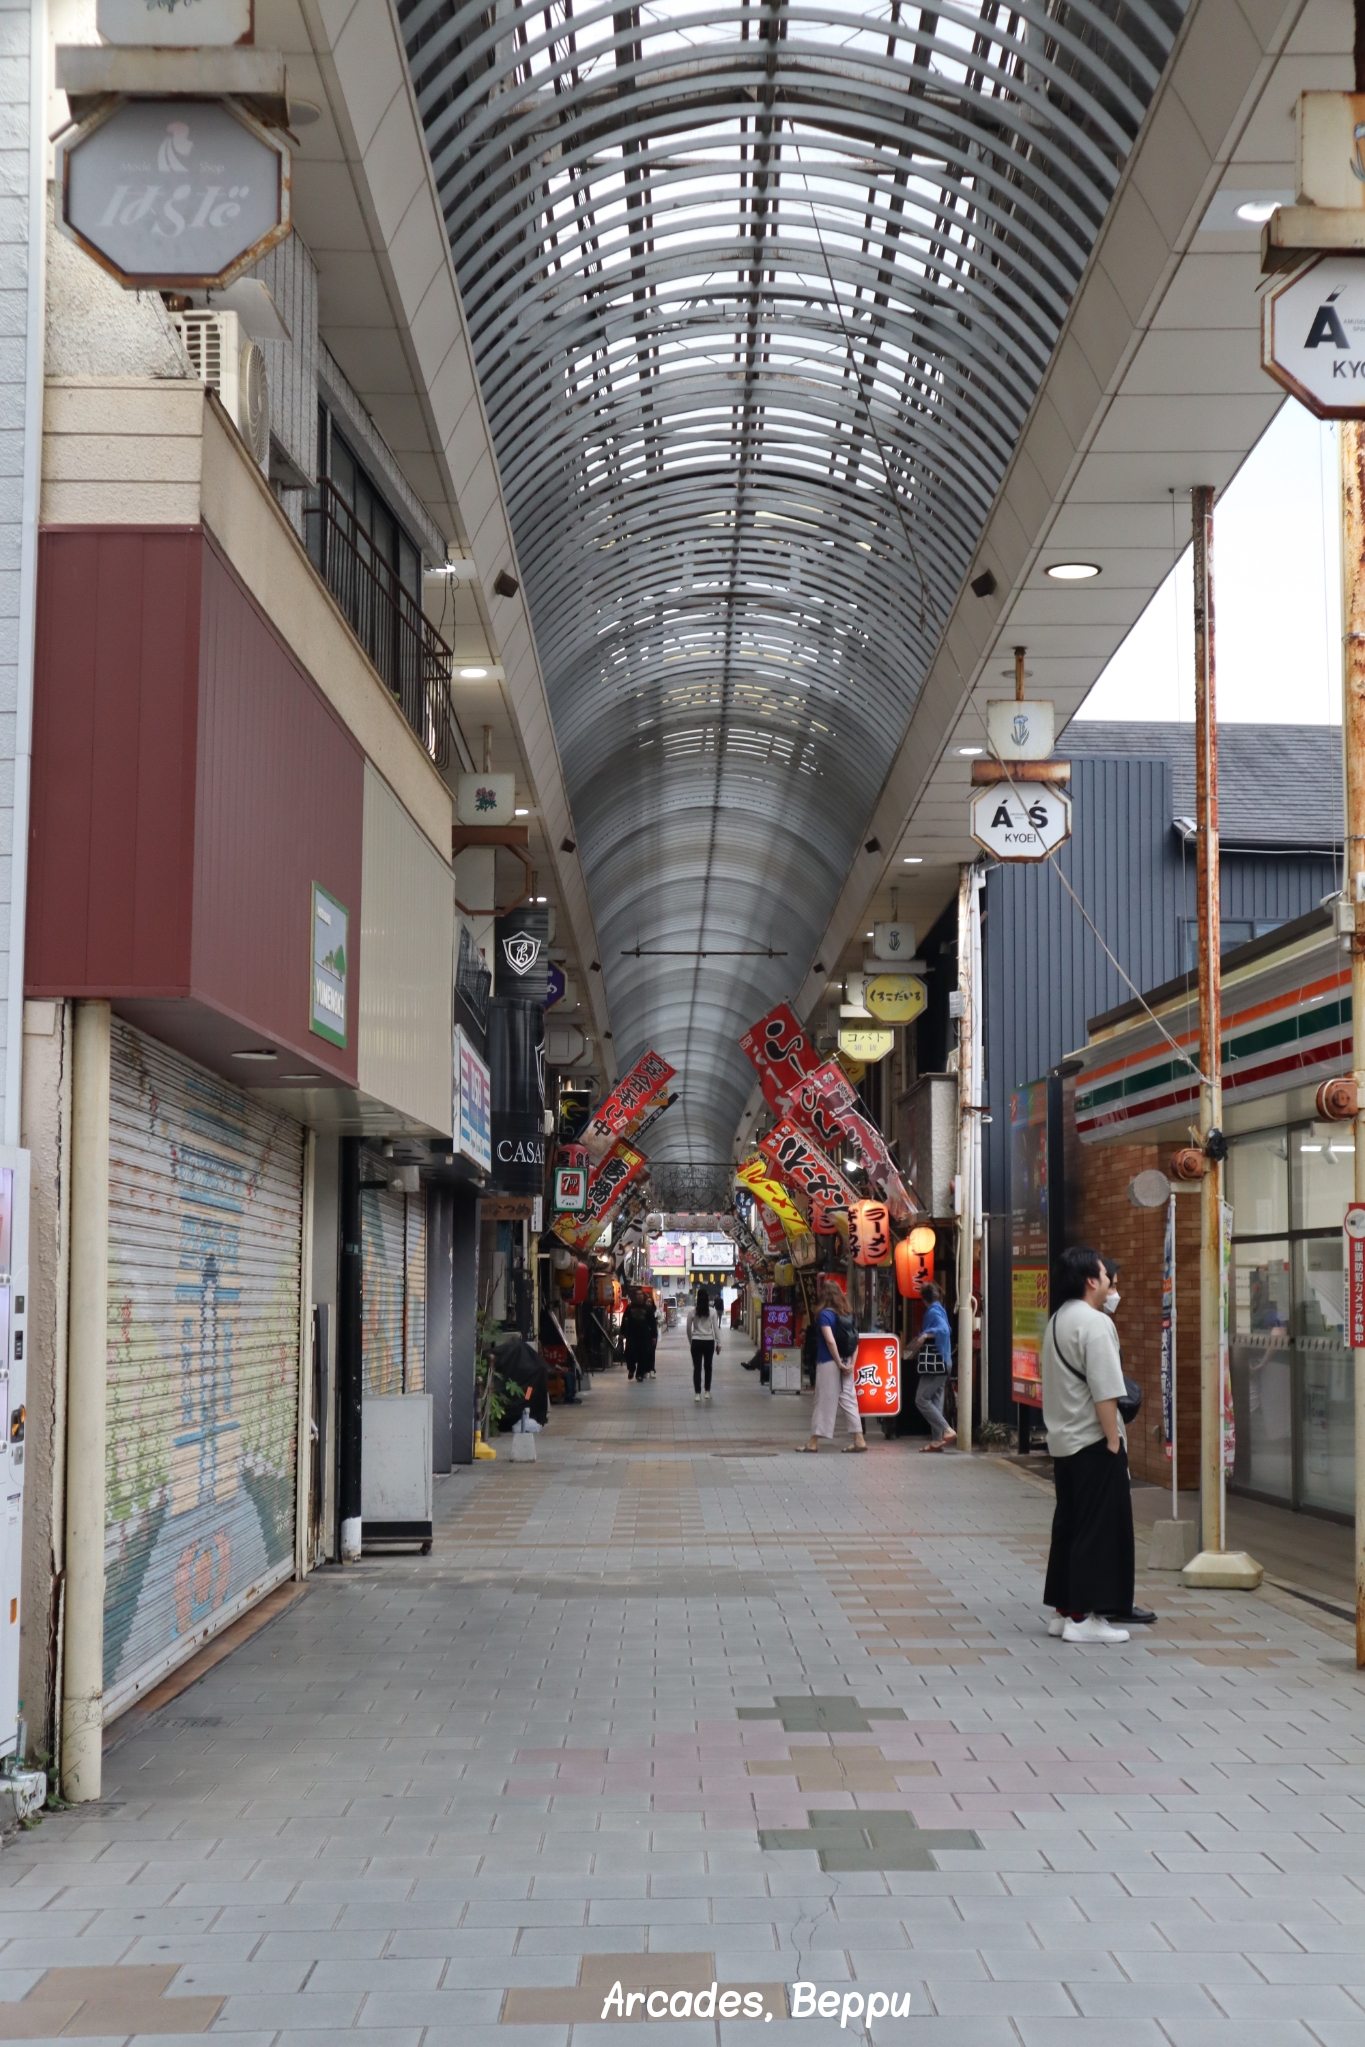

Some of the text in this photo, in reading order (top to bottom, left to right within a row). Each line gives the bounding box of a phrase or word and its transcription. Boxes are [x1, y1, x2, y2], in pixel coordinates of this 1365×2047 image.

[200, 162, 225, 174] Shop
[1005, 833, 1037, 843] KYOEI
[870, 989, 921, 1002] くろこだいる
[847, 1032, 884, 1043] コバト
[593, 1055, 669, 1137] 宴会承り中
[562, 1175, 578, 1191] 7up
[864, 1207, 888, 1259] ラーメン
[1354, 1241, 1364, 1343] 街頭防犯カメラ作動中
[855, 1366, 882, 1386] 風
[884, 1346, 898, 1404] ラーメン
